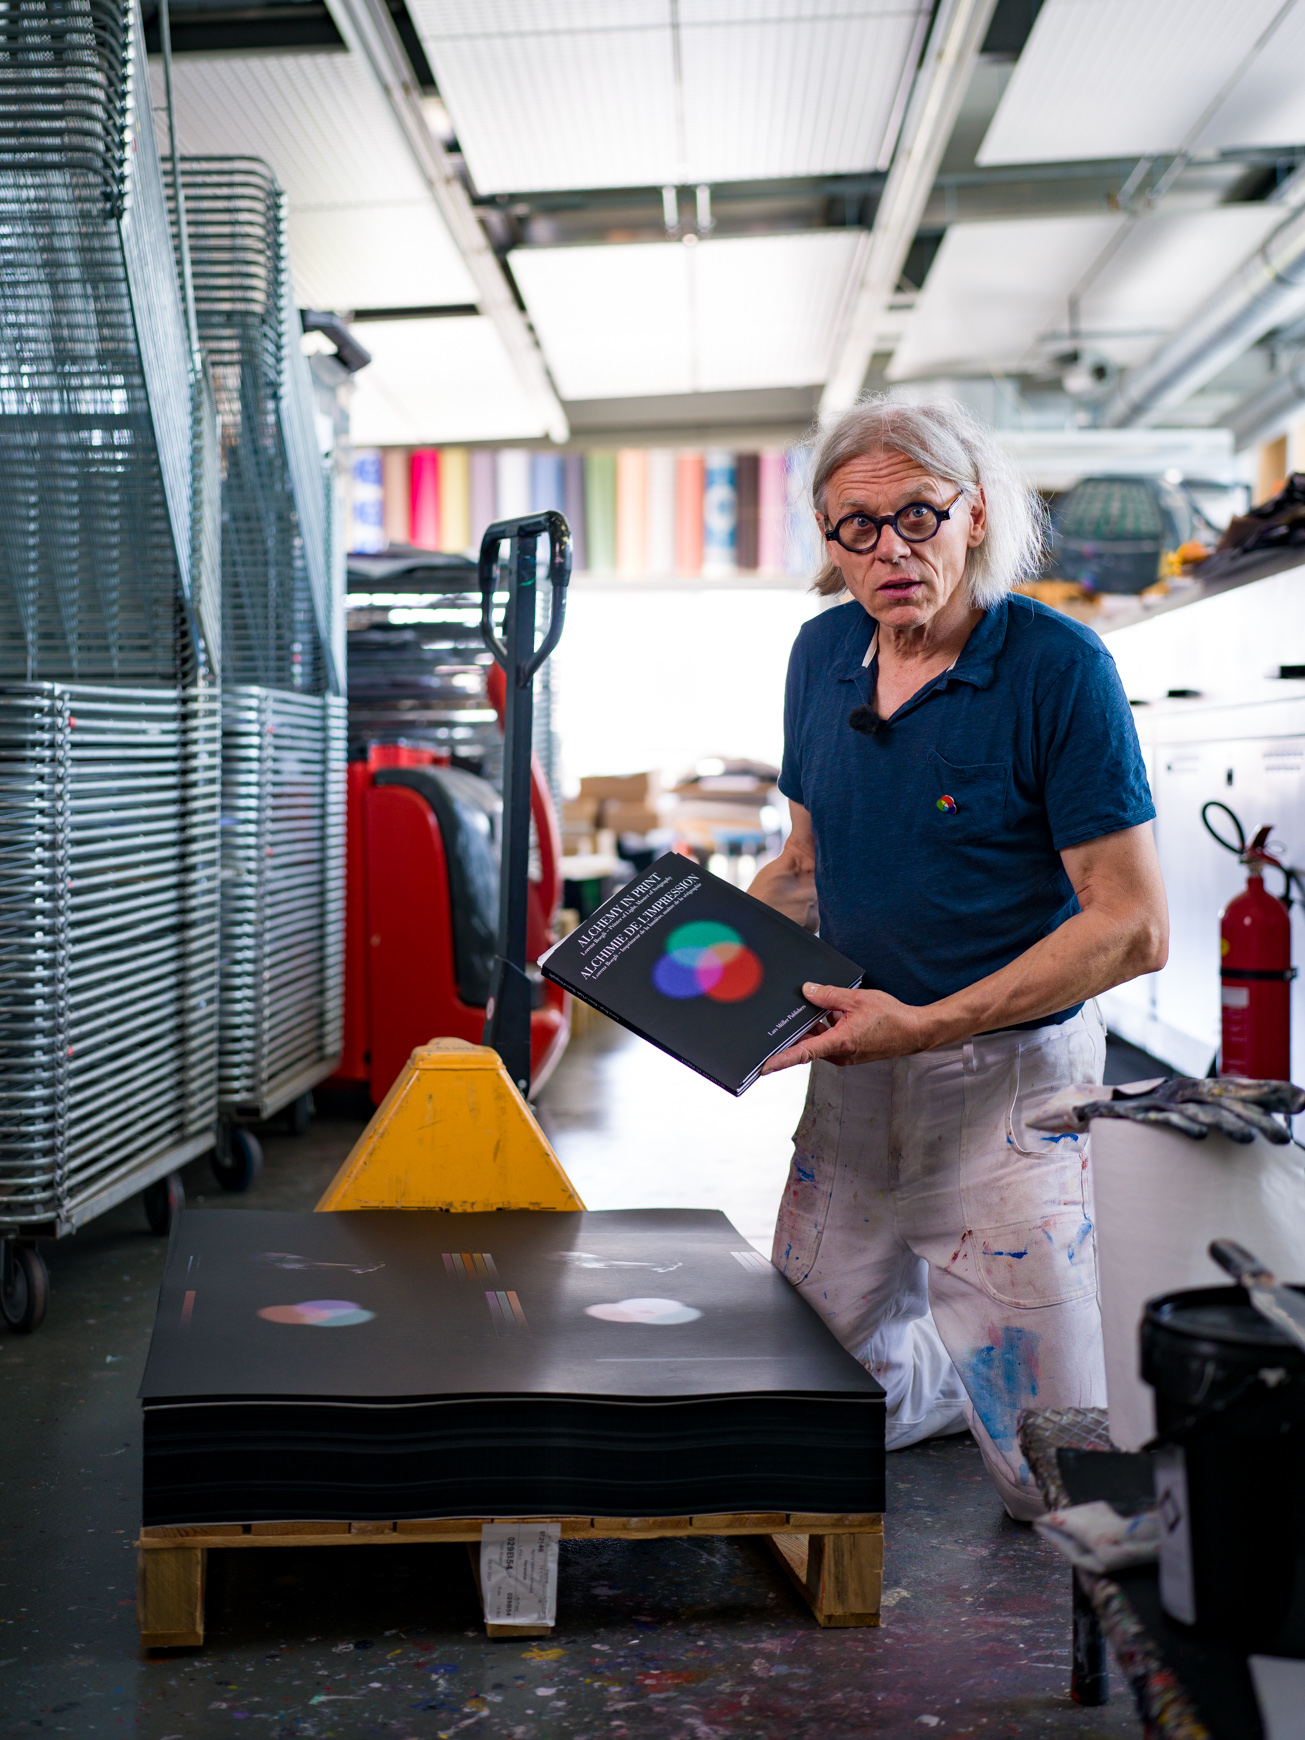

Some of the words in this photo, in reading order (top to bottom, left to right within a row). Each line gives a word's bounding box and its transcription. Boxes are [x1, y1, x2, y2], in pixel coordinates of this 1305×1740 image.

[578, 905, 623, 947] ALCHEMY
[620, 895, 635, 907] IN
[631, 872, 661, 897] PRINT
[581, 934, 628, 980] ALCHIMIE
[623, 922, 642, 936] DE
[637, 874, 699, 924] L'IMPRESSION
